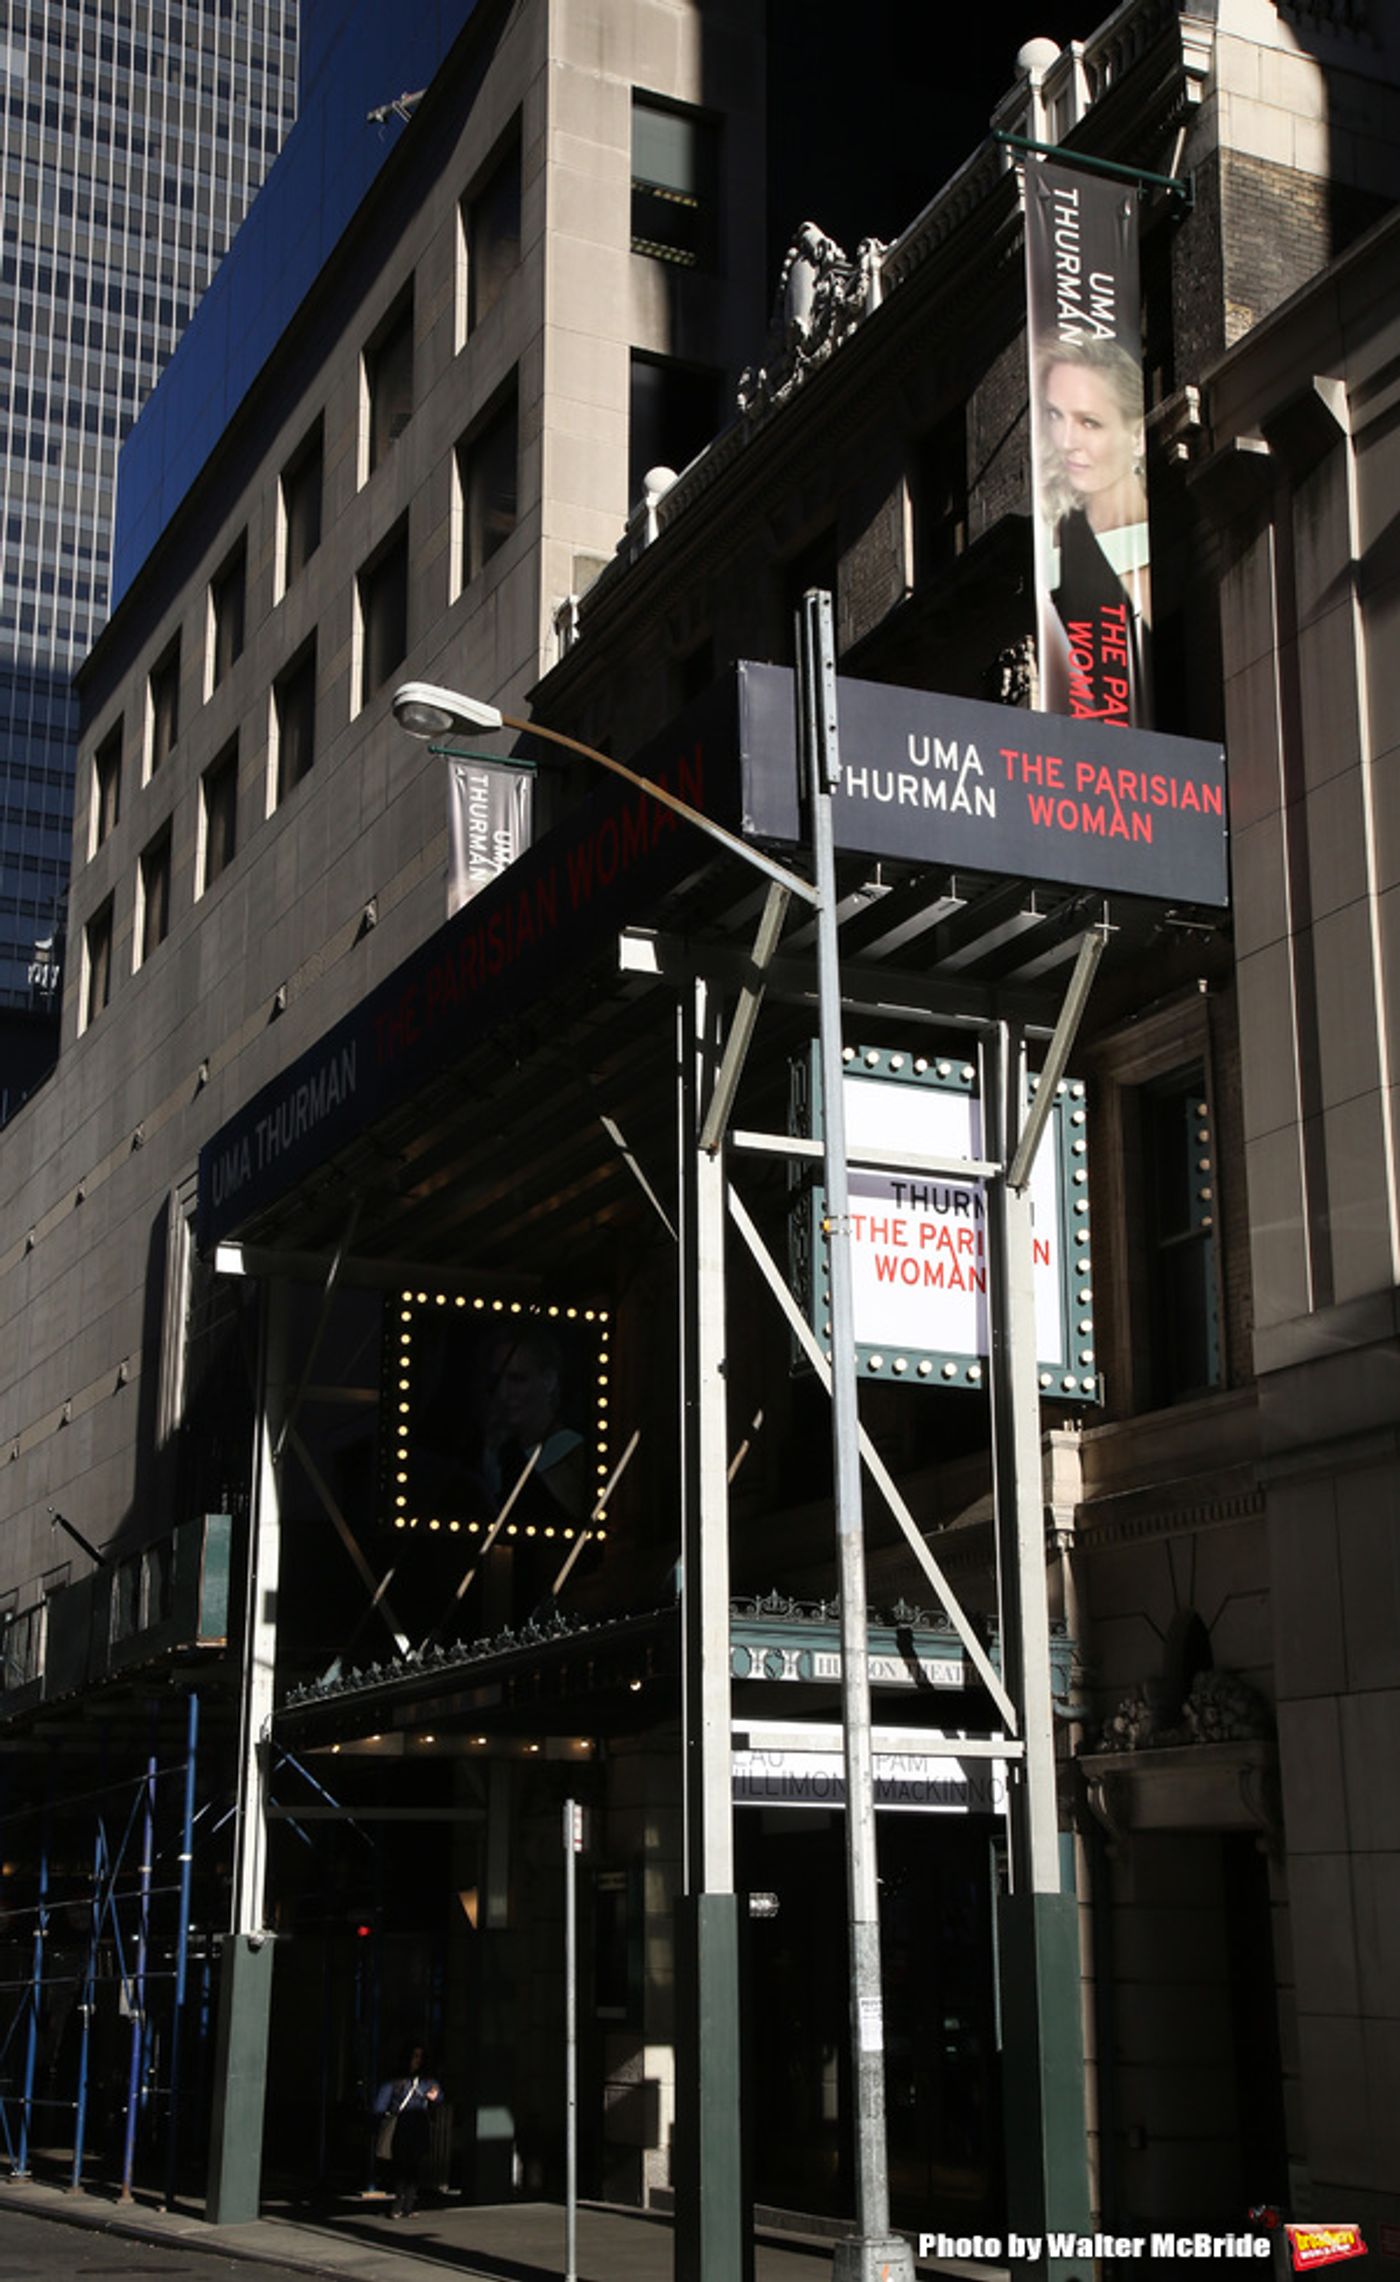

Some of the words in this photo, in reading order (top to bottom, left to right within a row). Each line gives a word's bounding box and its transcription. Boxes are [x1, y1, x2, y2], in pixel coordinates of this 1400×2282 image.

[1054, 188, 1084, 347] THURMAN
[1089, 272, 1117, 341] UMA
[1100, 603, 1127, 669] THE
[1068, 621, 1099, 720] WOMA
[908, 734, 984, 777] UMA
[1000, 748, 1066, 790] THE
[1076, 762, 1223, 816] PARISIAN
[468, 774, 490, 882] THURMAN
[1027, 793, 1154, 845] WOMAN
[211, 1136, 251, 1208] UMA
[254, 1038, 357, 1170] THURMAN
[373, 982, 422, 1065] THE
[424, 862, 559, 1028] PARISIAN
[565, 738, 705, 911] WOMAN
[850, 1213, 909, 1248] THE
[874, 1253, 987, 1294] WOMAN
[818, 1656, 897, 1678] HUON
